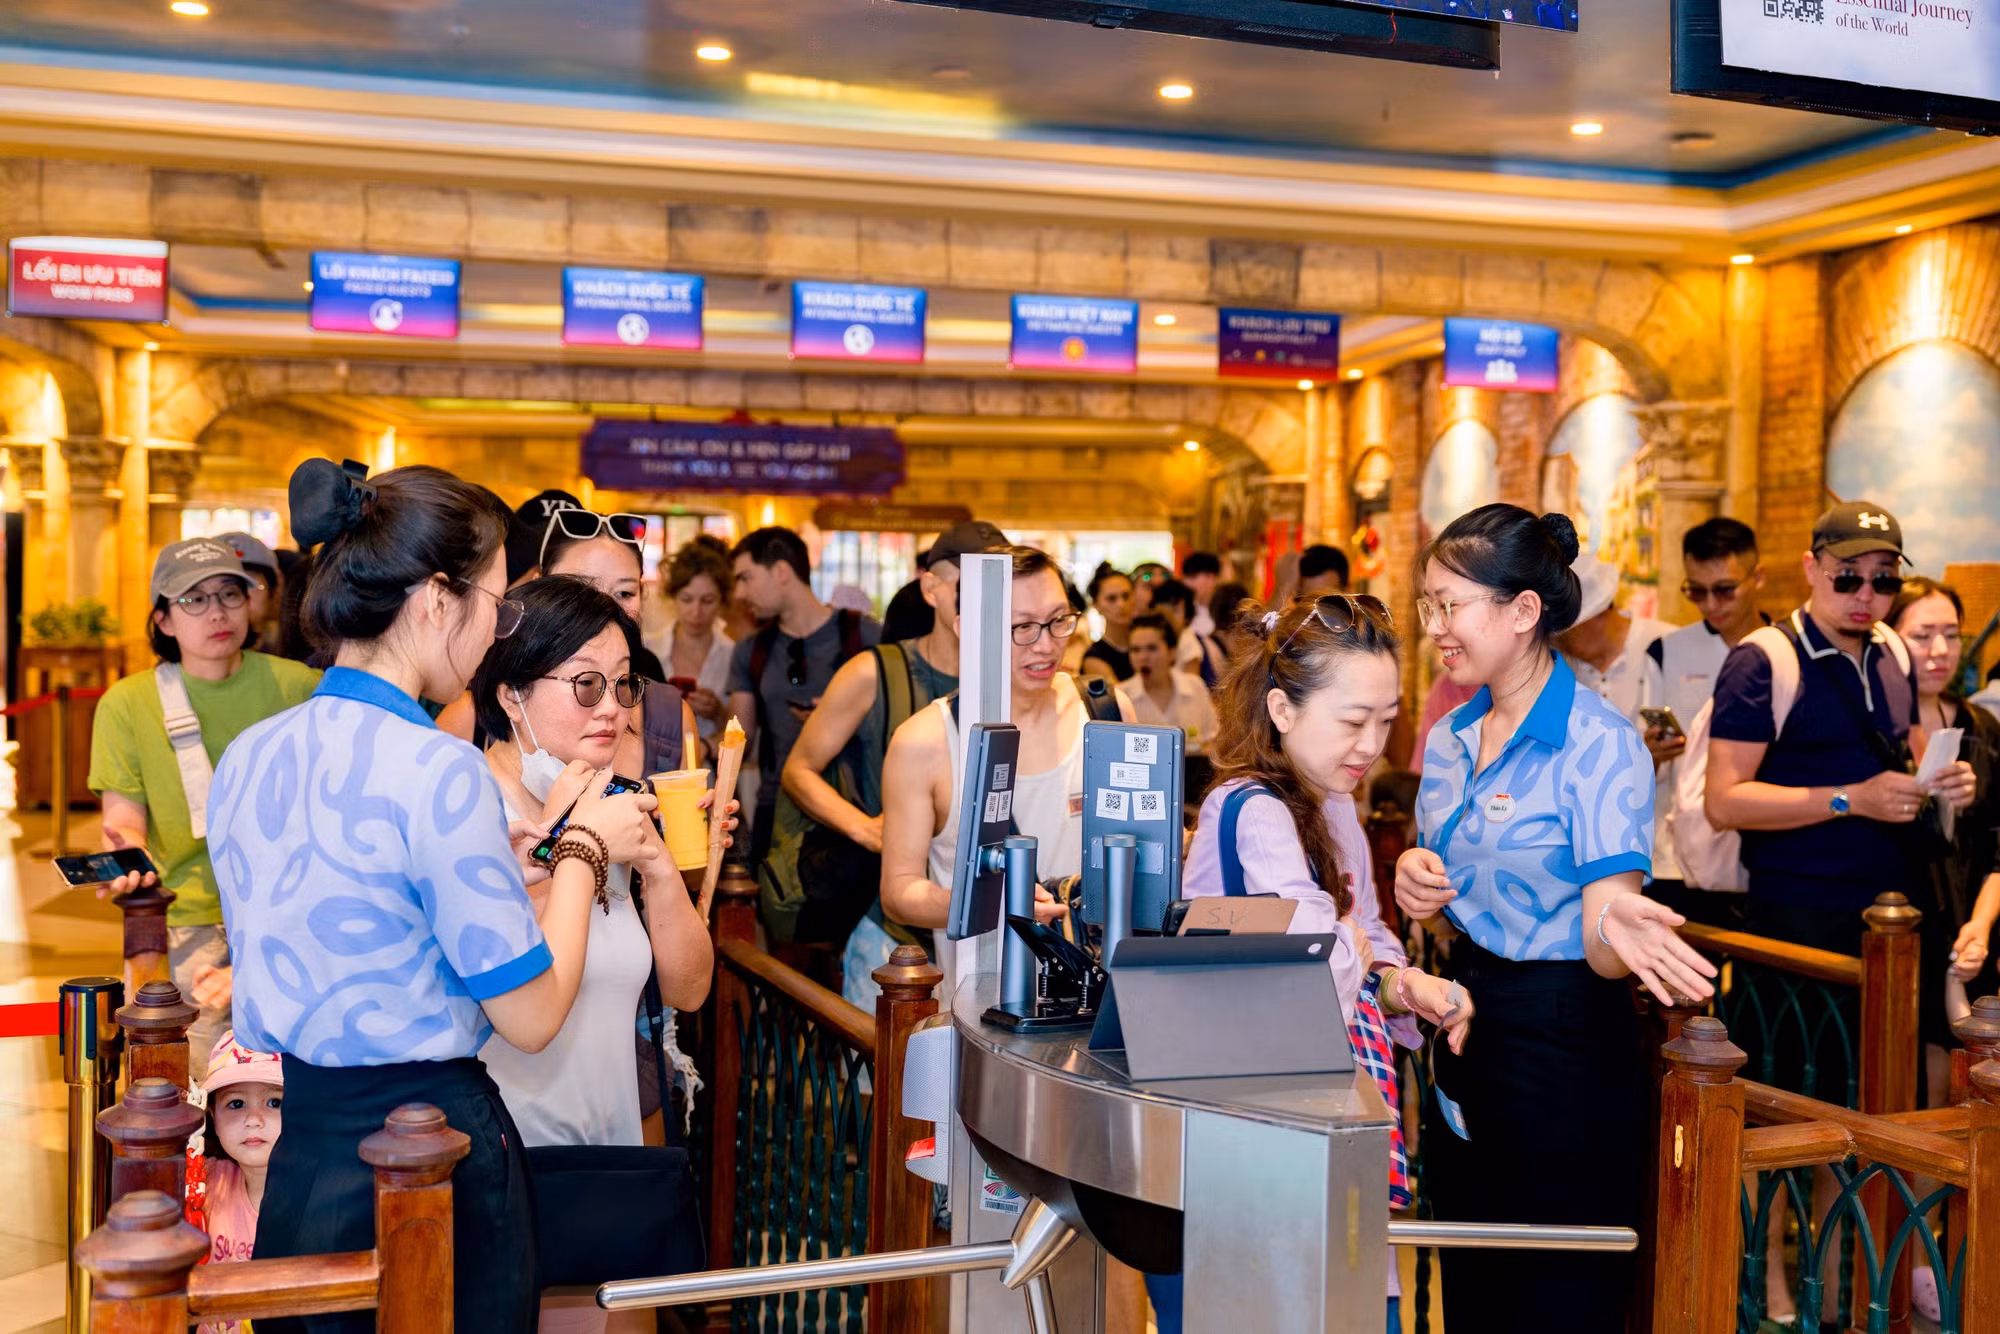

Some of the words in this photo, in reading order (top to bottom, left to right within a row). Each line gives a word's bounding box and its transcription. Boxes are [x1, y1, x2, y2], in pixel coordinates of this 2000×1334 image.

[1835, 0, 1908, 13] ential
[1911, 0, 1973, 29] Journey
[1836, 12, 1849, 28] of
[1850, 15, 1869, 30] the
[1872, 17, 1909, 36] World
